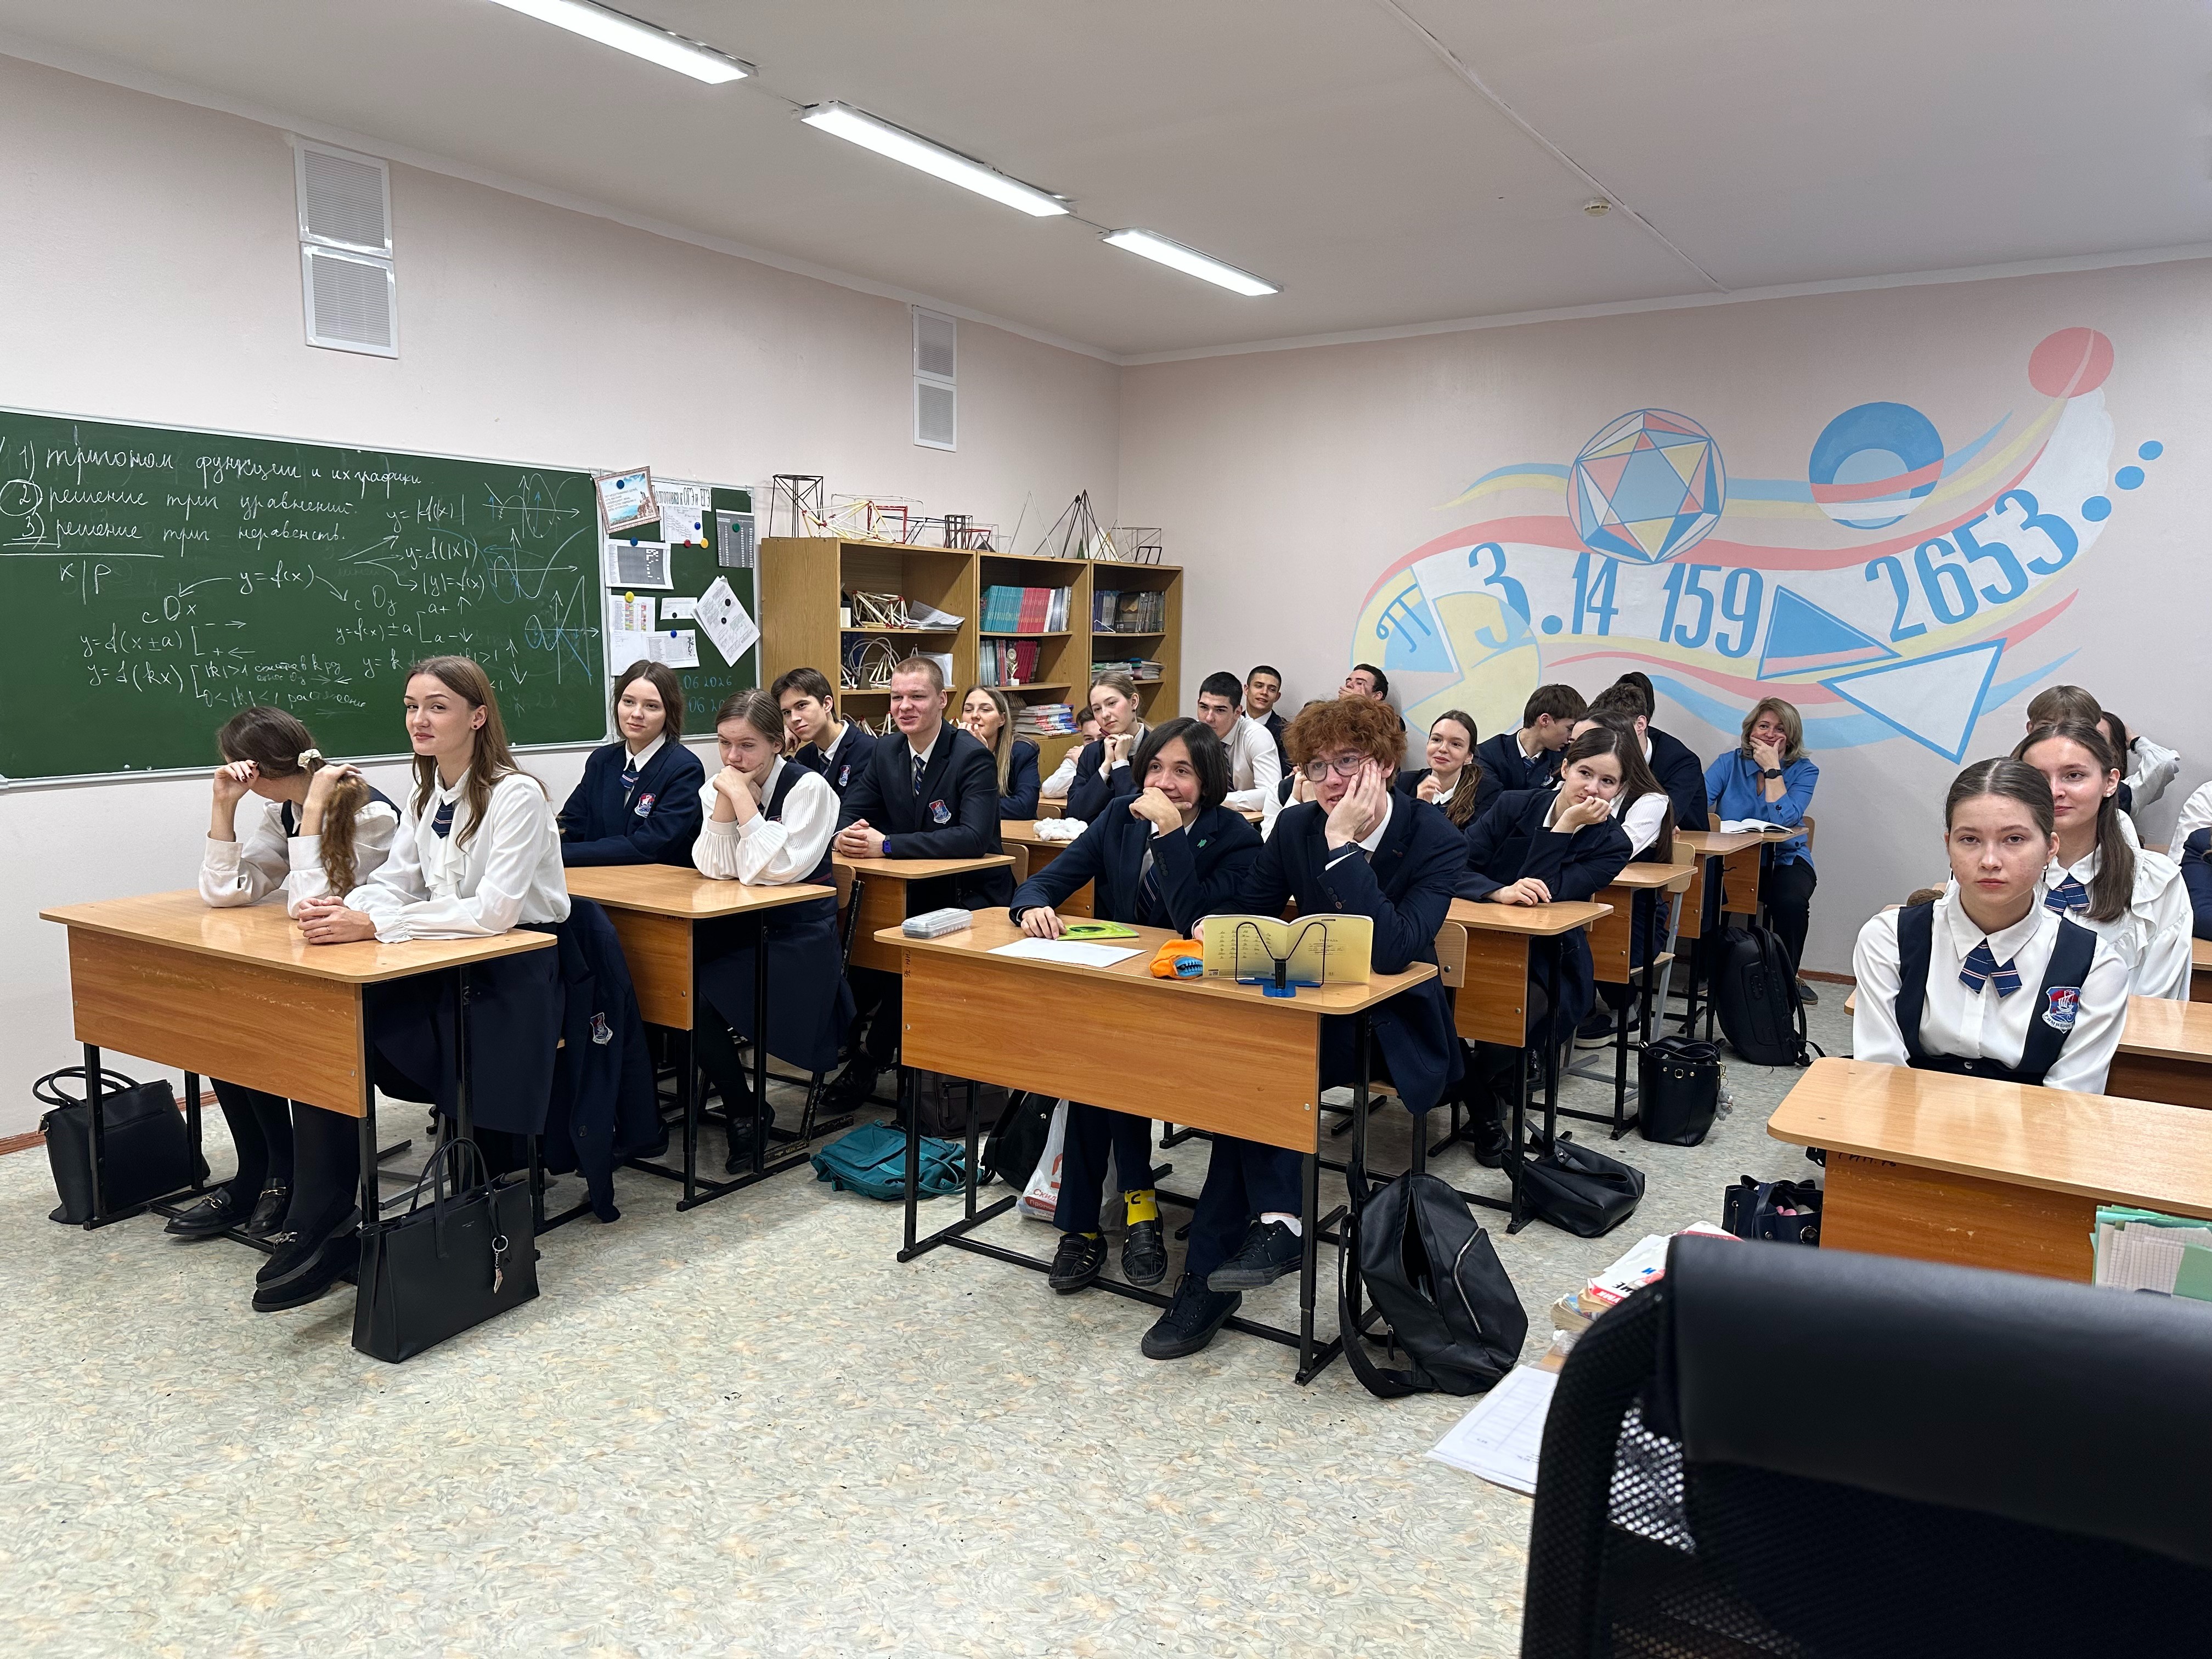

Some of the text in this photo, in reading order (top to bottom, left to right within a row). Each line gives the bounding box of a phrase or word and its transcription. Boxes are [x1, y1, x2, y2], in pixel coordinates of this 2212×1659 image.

[196, 455, 301, 489] функции
[312, 468, 321, 478] и
[50, 486, 149, 512] решение
[167, 493, 218, 521] триг
[700, 488, 710, 507] ЕГЭ
[57, 519, 143, 548] решение
[164, 527, 210, 556] триг
[1658, 562, 1764, 658] 159
